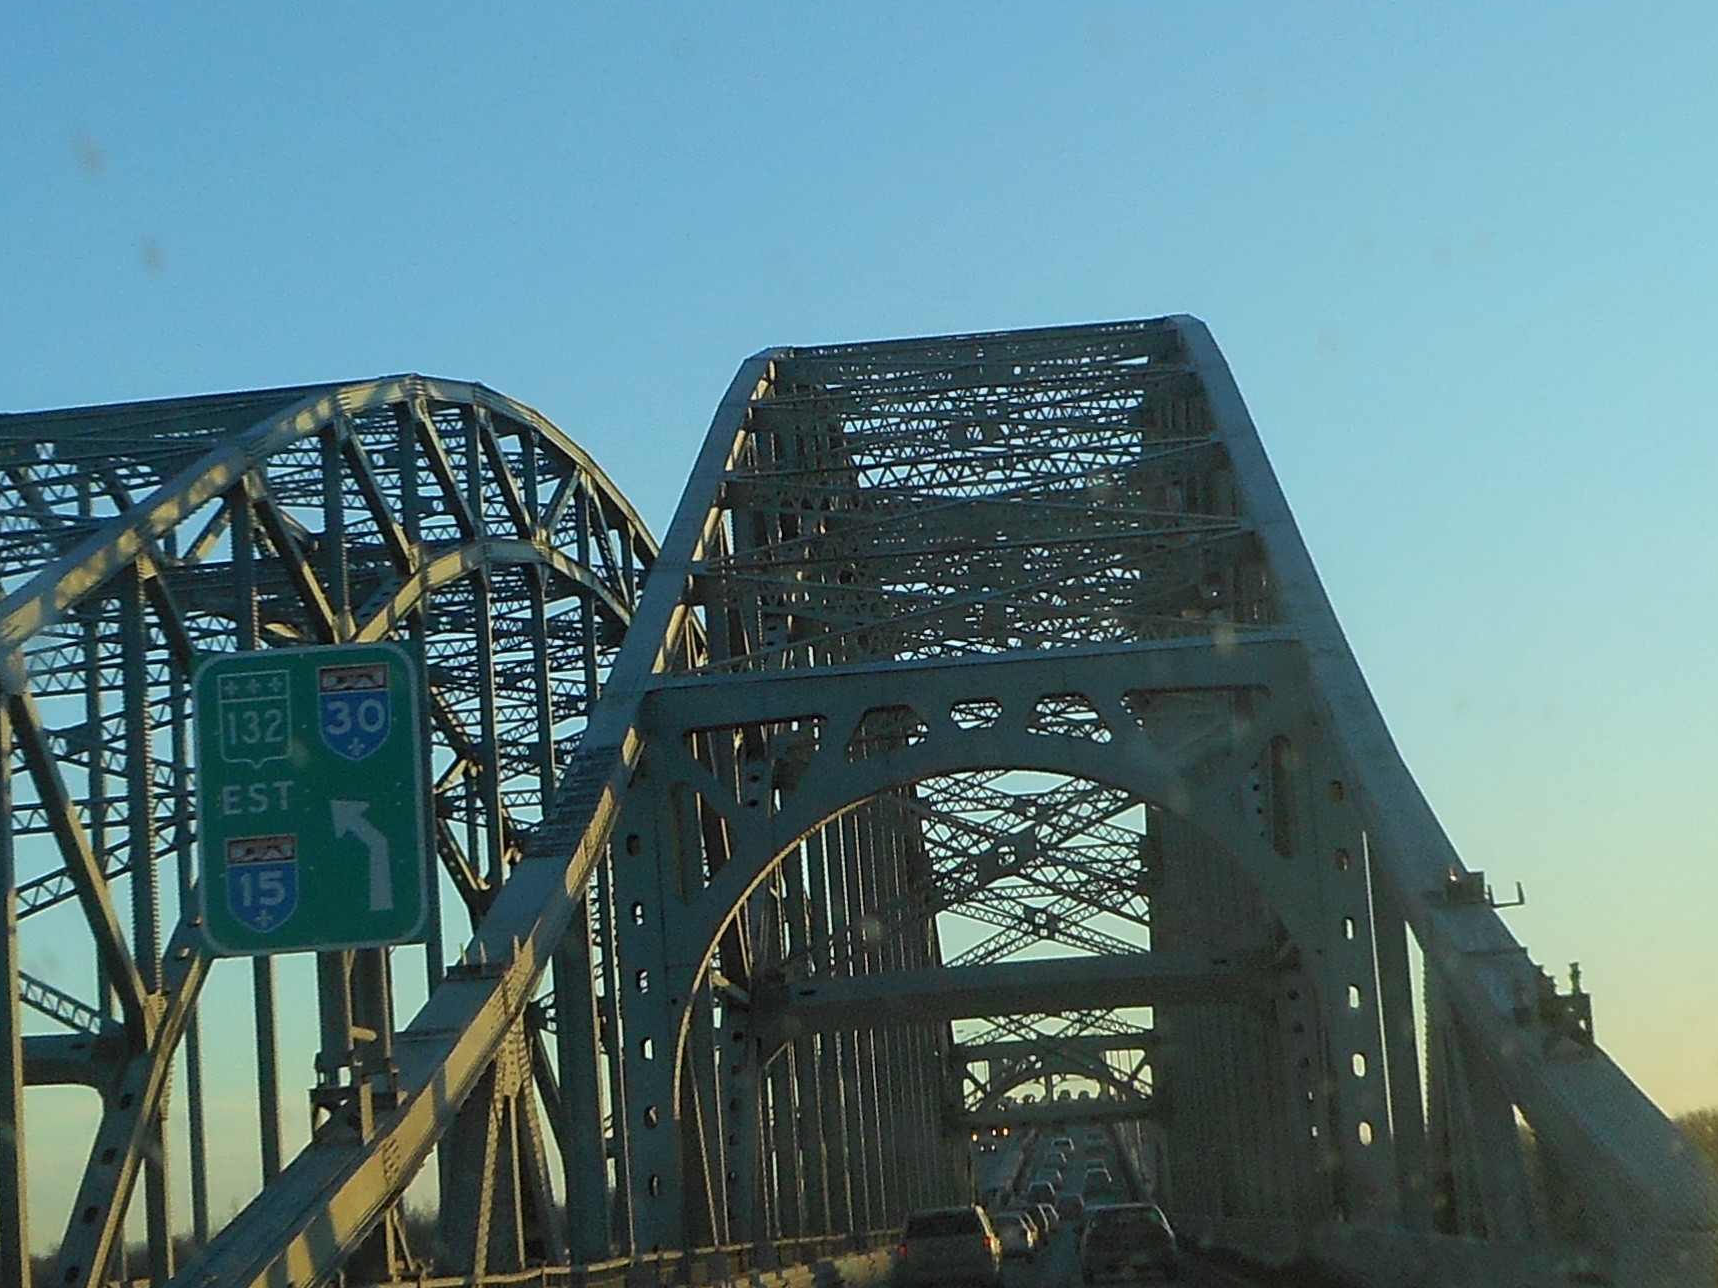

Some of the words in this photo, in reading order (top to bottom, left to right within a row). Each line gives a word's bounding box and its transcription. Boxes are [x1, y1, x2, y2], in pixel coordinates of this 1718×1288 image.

[228, 707, 283, 745] 132
[325, 697, 385, 736] 30
[223, 780, 295, 815] EST
[239, 870, 285, 908] 15
